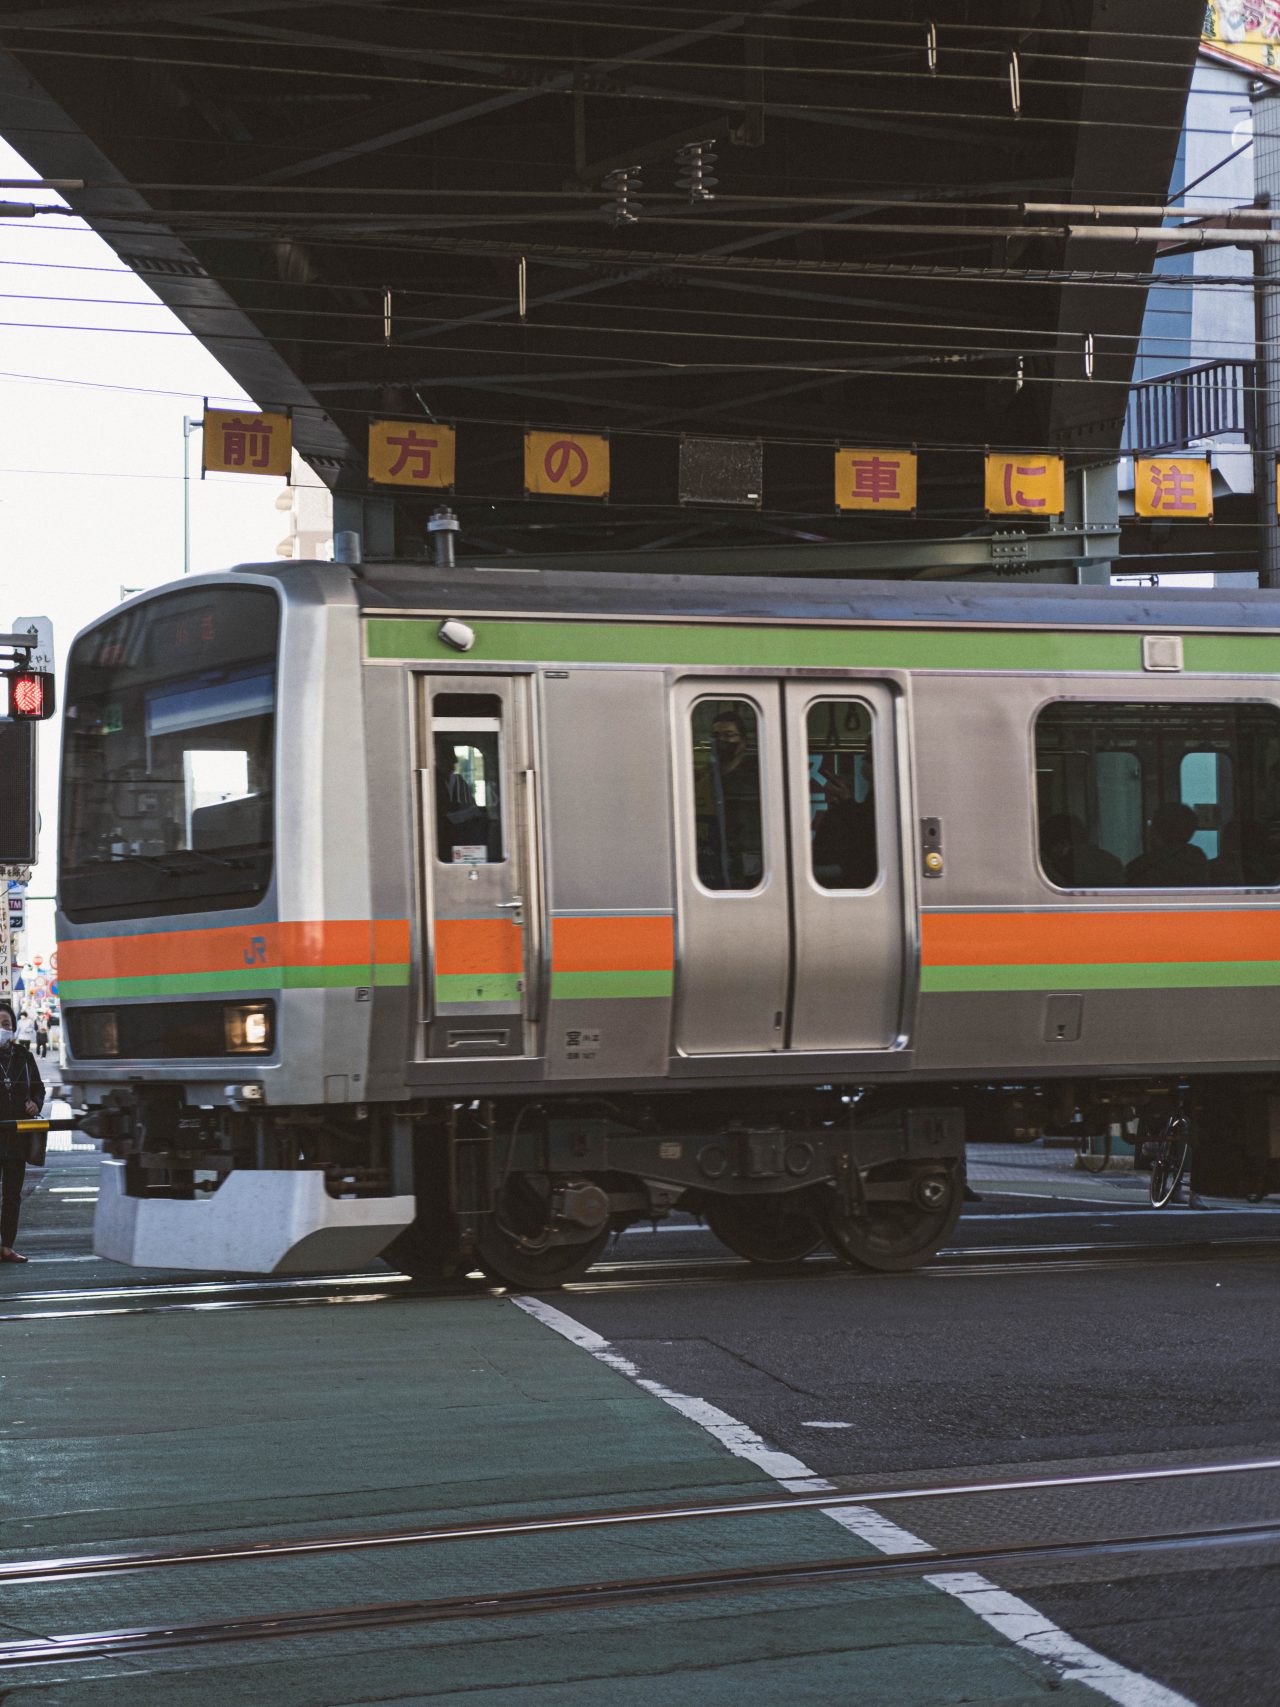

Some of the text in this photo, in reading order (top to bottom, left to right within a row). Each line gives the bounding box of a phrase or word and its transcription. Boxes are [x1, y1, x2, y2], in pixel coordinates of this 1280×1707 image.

[222, 418, 1197, 510] 前 方 の 車 に 注
[244, 936, 267, 964] JR
